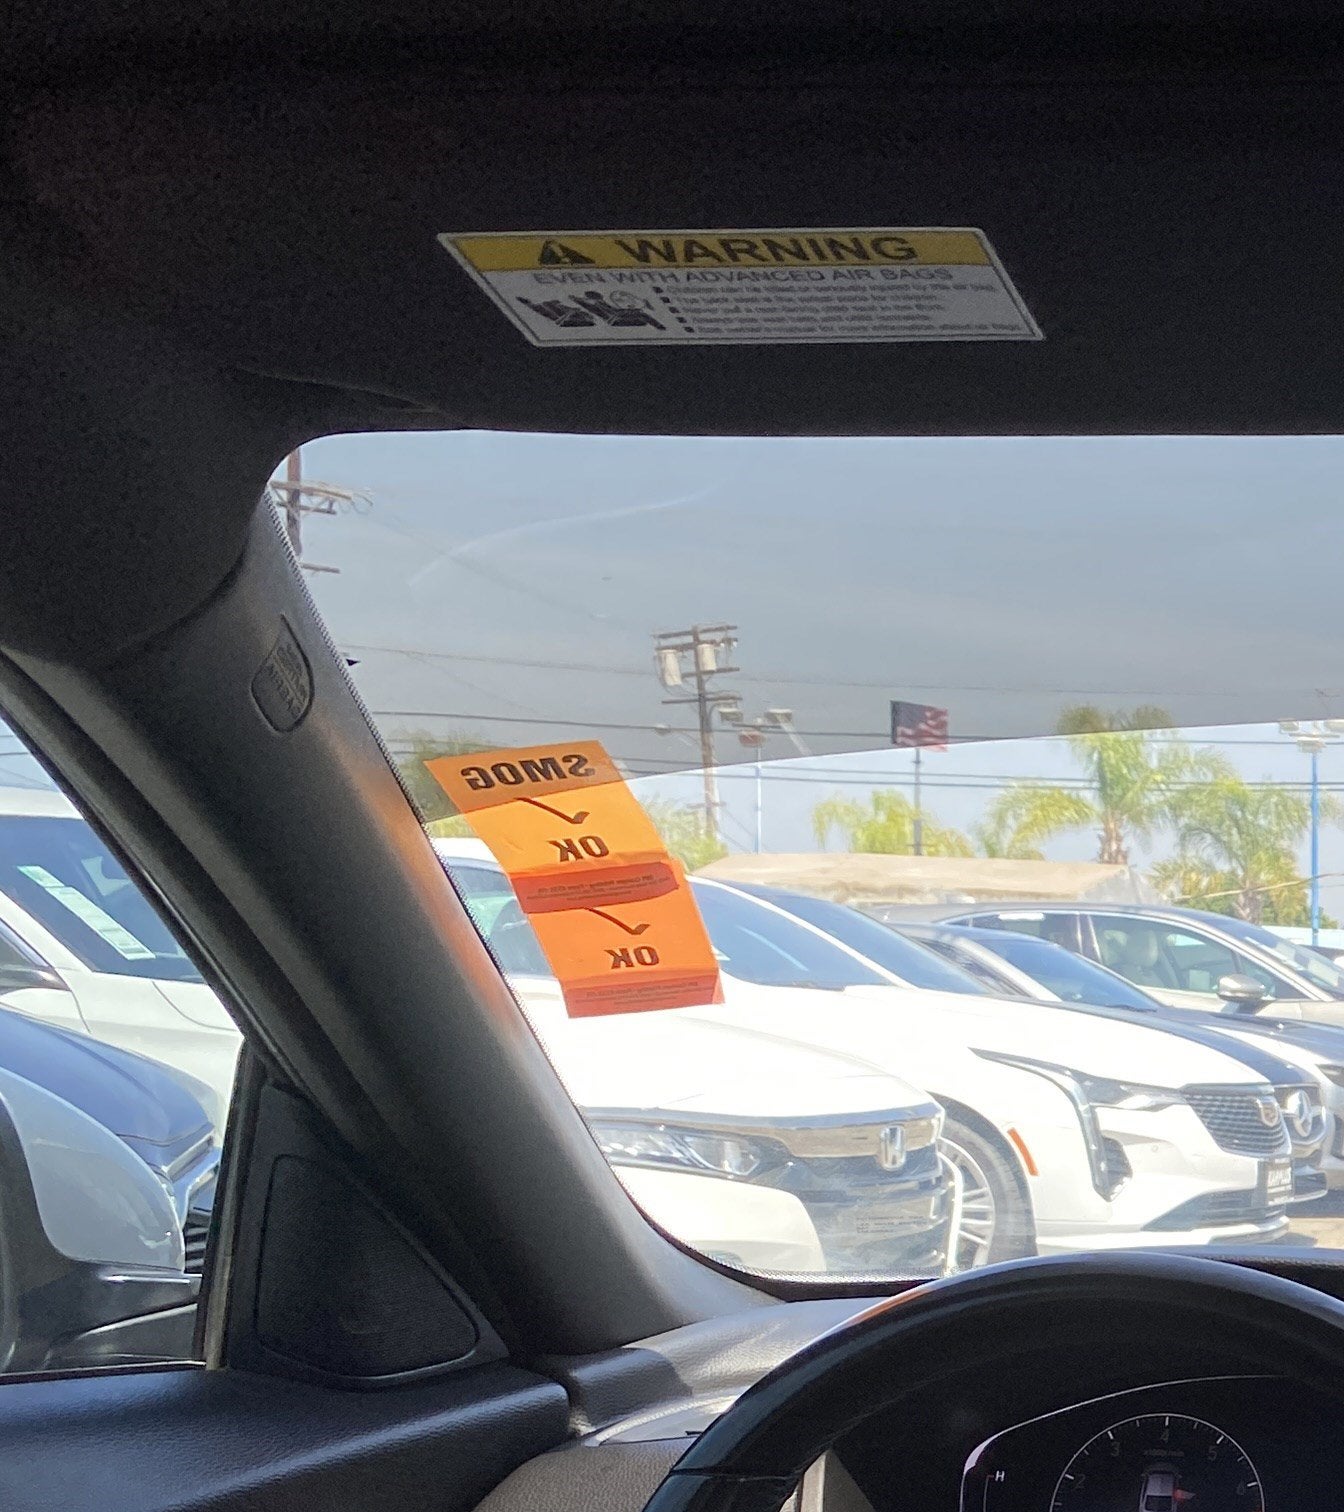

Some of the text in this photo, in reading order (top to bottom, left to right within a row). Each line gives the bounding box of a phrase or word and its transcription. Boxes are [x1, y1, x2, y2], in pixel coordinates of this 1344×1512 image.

[613, 236, 918, 263] WARNING
[534, 267, 953, 285] EVEN WITH ADVANCED AIR BAGS
[1159, 1429, 1170, 1444] 4
[1110, 1441, 1120, 1457] 3
[1208, 1444, 1218, 1460] 5
[994, 1471, 1006, 1482] H
[1074, 1474, 1085, 1489] 2
